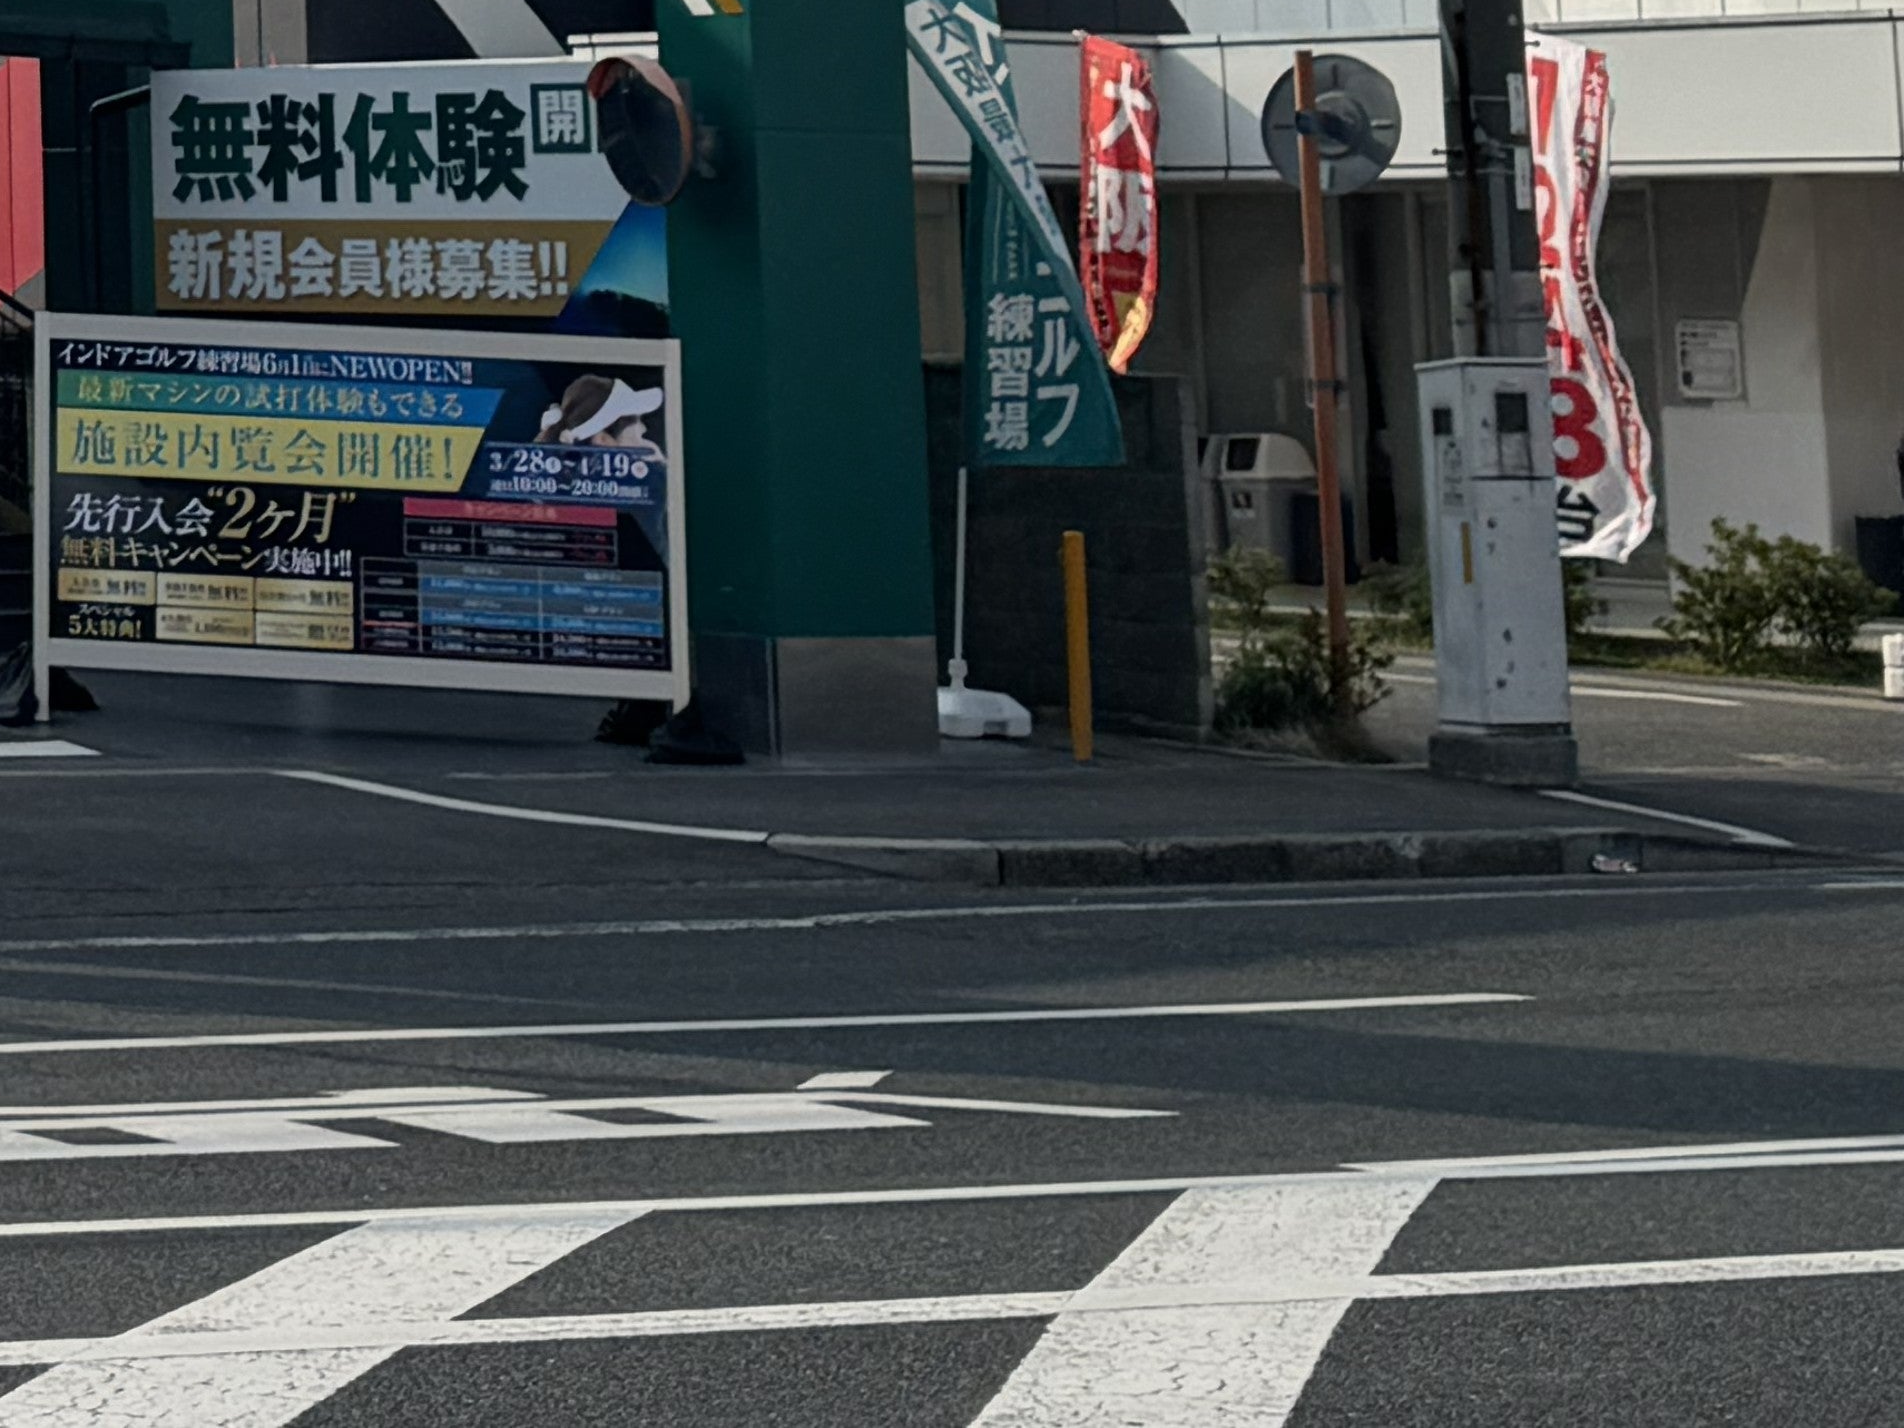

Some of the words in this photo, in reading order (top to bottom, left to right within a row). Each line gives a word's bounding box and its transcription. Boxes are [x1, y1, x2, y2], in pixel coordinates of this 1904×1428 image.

[169, 89, 530, 204] 無料体験
[167, 229, 569, 302] 新規会員様募集!!
[983, 292, 1035, 451] 練習場
[72, 418, 453, 481] 施設内覧会開催!
